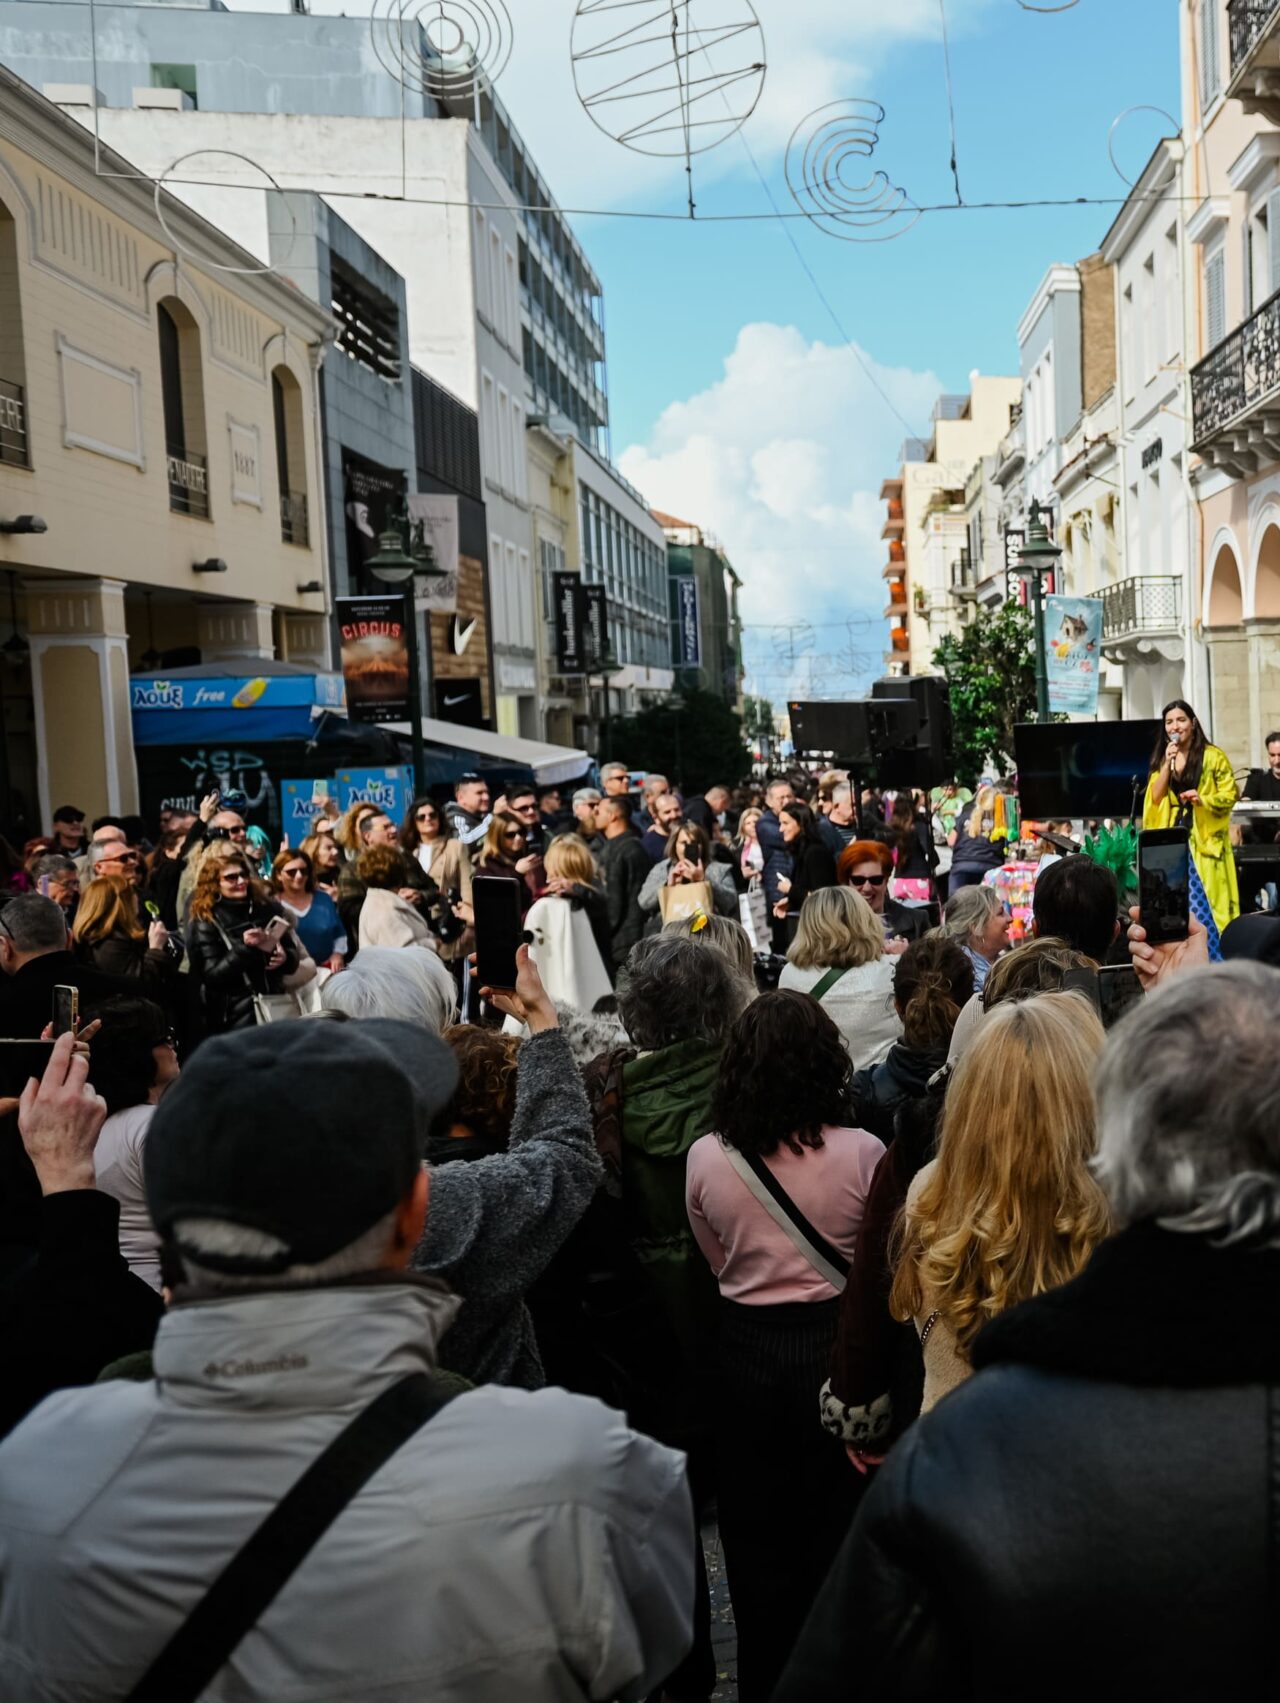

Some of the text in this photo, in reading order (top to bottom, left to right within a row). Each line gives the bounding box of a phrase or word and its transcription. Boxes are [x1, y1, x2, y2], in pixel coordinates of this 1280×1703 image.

[342, 621, 401, 640] CIRCUS
[193, 686, 225, 705] free
[220, 1353, 309, 1378] Columbia
